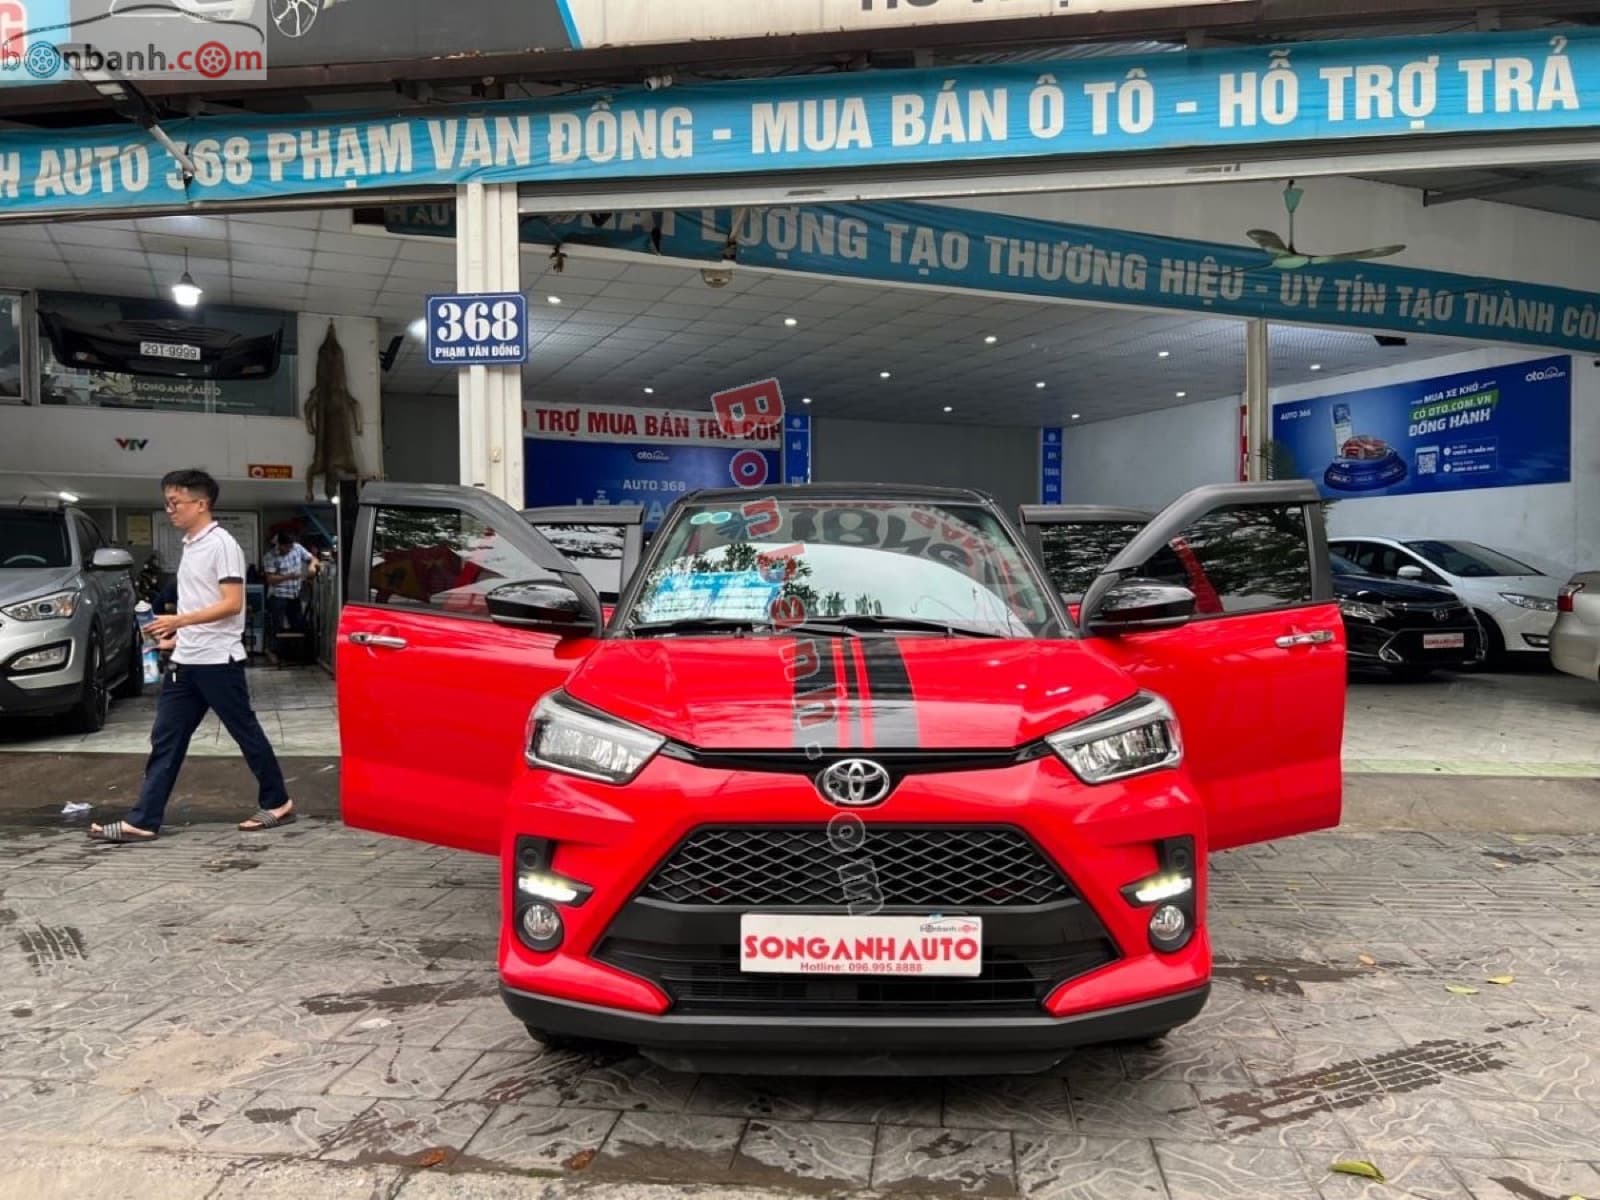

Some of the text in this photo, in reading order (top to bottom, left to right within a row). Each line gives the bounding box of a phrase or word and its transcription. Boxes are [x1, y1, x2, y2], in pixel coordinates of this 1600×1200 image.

[34, 144, 149, 197] AUTO
[165, 136, 253, 190] 368
[267, 119, 413, 189] PHẠM
[750, 97, 872, 154] MUA
[891, 79, 1008, 147] BÁN
[1028, 73, 1065, 139] Ô
[1084, 67, 1155, 135] TÔ
[1219, 48, 1299, 128] HỖ
[1319, 55, 1440, 129] TRỢ
[1458, 36, 1580, 114] TRẢ
[884, 223, 970, 276] TẠO
[984, 235, 1147, 291] THƯƠNG
[1160, 256, 1244, 305] HIỆU
[1279, 272, 1325, 309] UY
[1334, 274, 1387, 315] TÍN
[1396, 286, 1454, 326] TẠO
[1464, 289, 1554, 334] THÀNH
[437, 301, 519, 342] 368
[435, 347, 467, 360] PHẠM
[468, 344, 489, 357] VĂN
[1424, 391, 1445, 404] MUA
[1446, 388, 1458, 398] XE
[1413, 394, 1493, 421] CÓ OTO.COM.VN
[535, 407, 580, 437] TRỢ
[587, 411, 638, 435] MUA
[644, 411, 689, 438] BÁN
[1449, 408, 1491, 429] HÀNH
[115, 438, 148, 450] VTV
[623, 479, 687, 492] AUTO 368
[848, 963, 923, 973] 096.995.8888
